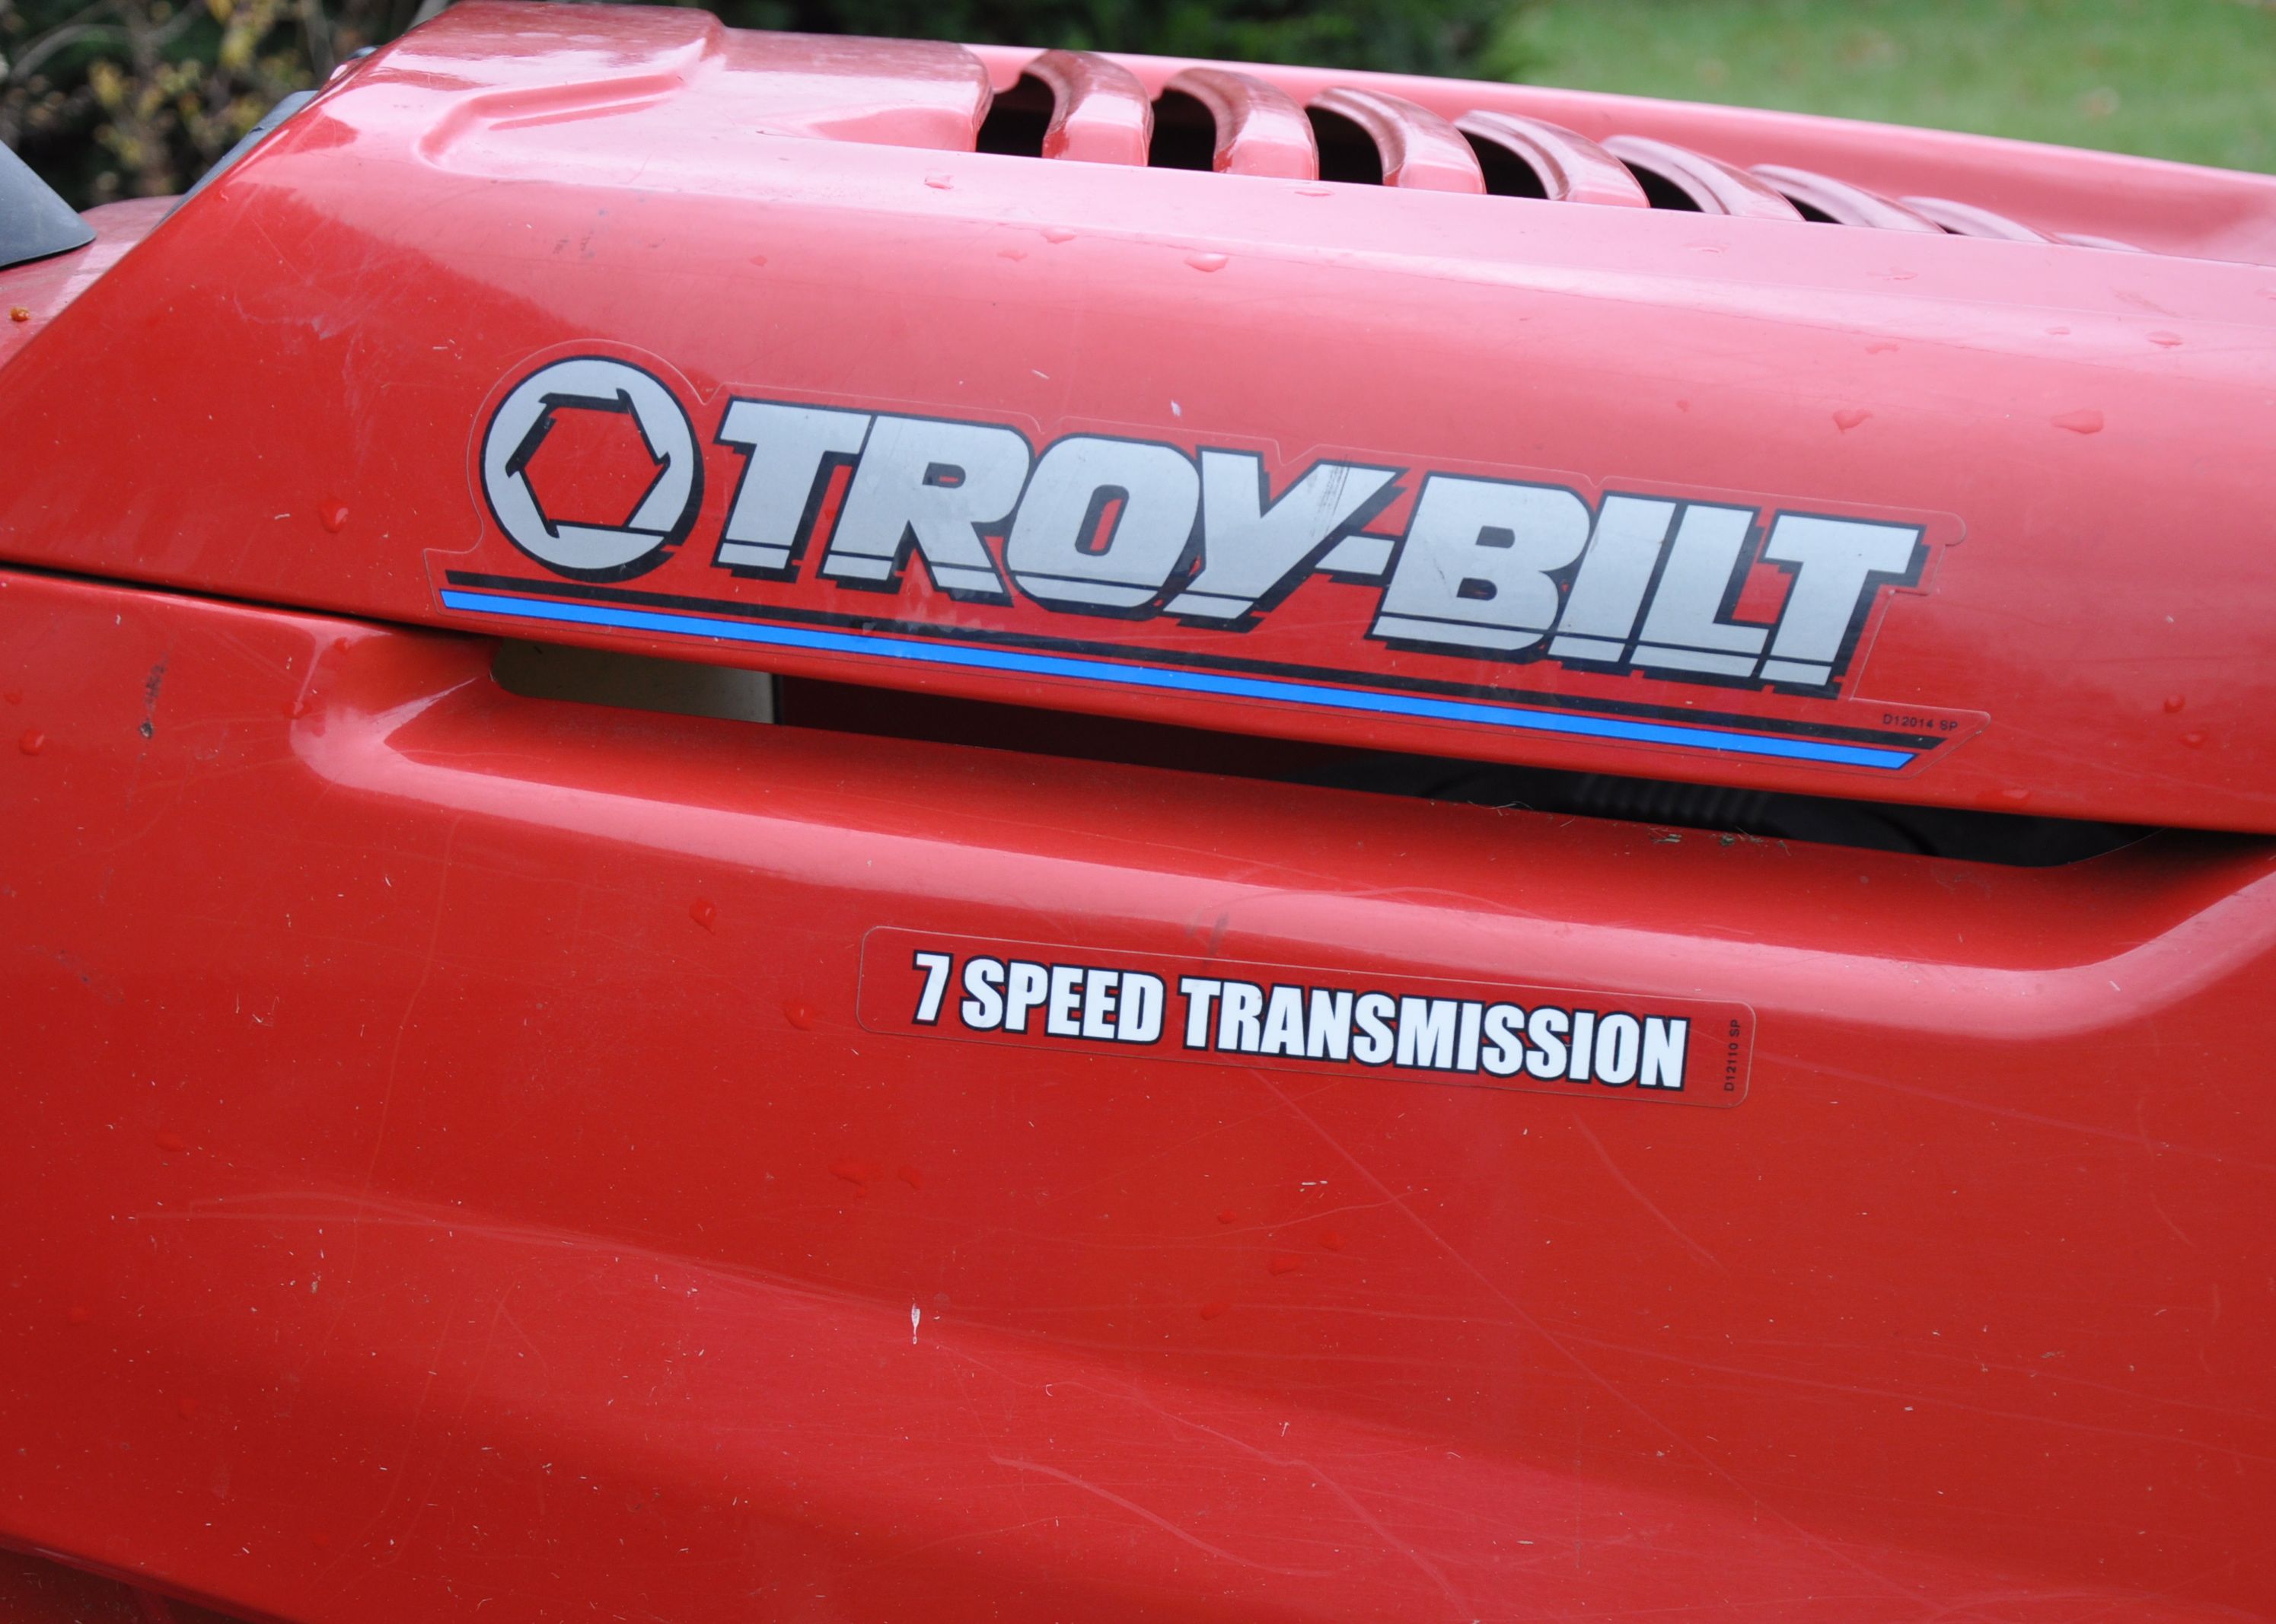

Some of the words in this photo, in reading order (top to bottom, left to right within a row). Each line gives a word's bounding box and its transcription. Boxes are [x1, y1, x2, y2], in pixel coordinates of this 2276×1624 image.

[716, 396, 1927, 697] TROY-BILT
[1882, 714, 1933, 728] D12014
[1940, 719, 1958, 731] SP
[913, 951, 952, 1024] 7
[960, 956, 1165, 1045] SPEED
[1178, 975, 1689, 1090] TRANSMISSION
[1729, 1019, 1740, 1036] SP
[1723, 1043, 1739, 1091] D12110
